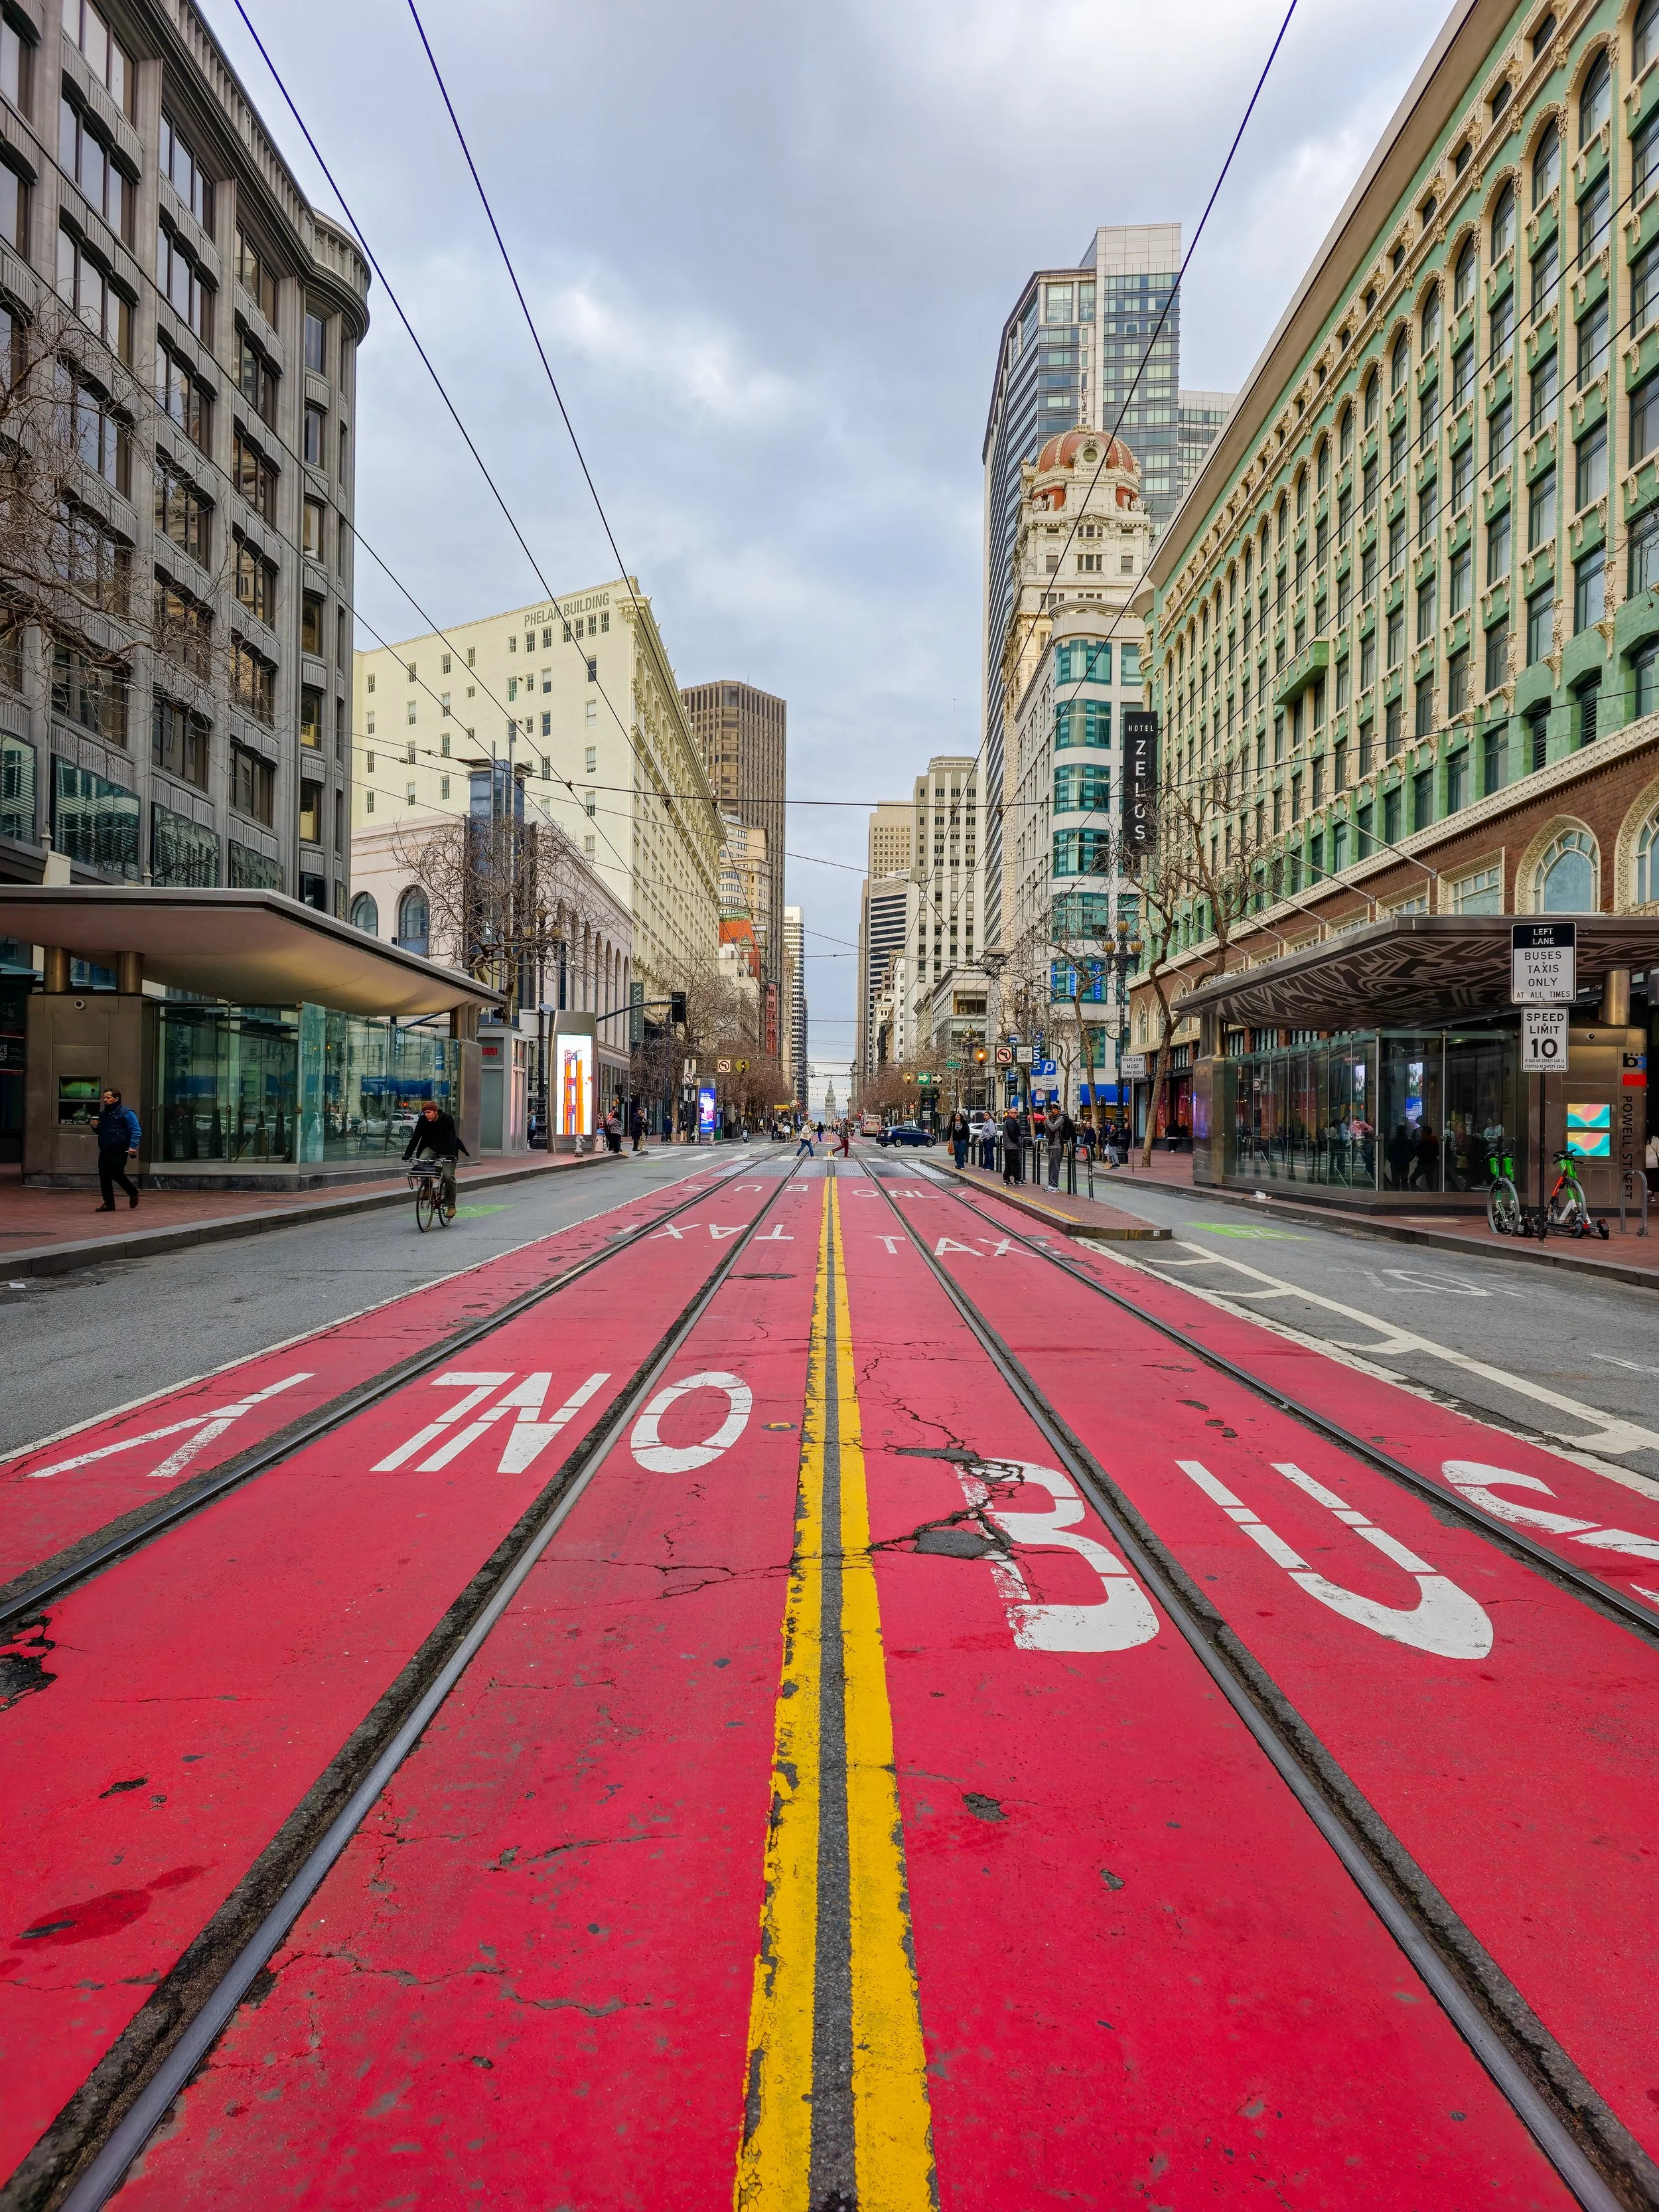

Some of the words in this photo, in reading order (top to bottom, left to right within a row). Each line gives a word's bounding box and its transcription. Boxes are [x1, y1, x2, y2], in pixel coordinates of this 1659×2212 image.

[524, 603, 561, 627] PHELAN
[564, 592, 609, 617] BUILDING
[1134, 740, 1147, 840] ZELOS
[1524, 950, 1561, 960] BUSES
[1527, 964, 1559, 974] TAXIS
[1528, 978, 1557, 987] ONLY
[1526, 1013, 1564, 1021] SPEED
[1530, 1025, 1559, 1034] LIMIT
[1532, 1038, 1558, 1058] 10
[1623, 1096, 1632, 1147] POWELL
[25, 1370, 753, 1477] ONLY
[954, 1457, 1659, 1660] BUS
